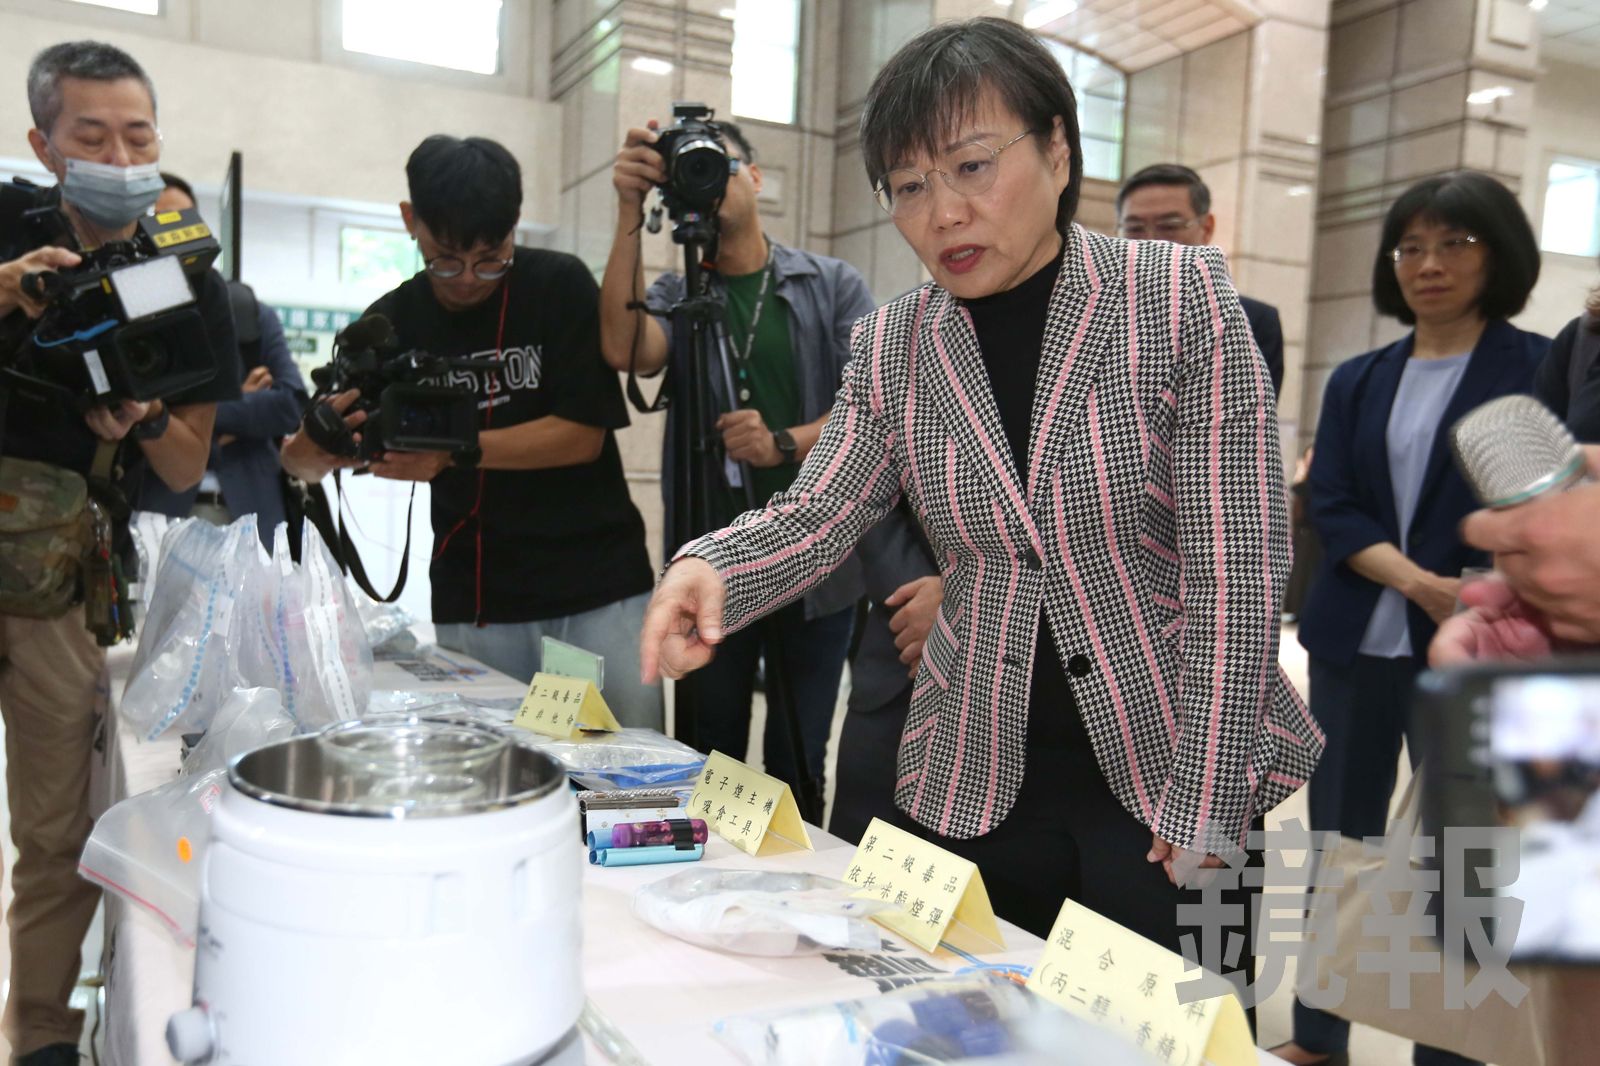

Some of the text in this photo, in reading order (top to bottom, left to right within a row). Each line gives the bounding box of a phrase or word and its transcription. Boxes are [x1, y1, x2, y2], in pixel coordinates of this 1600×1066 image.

[704, 768, 774, 816] 電子煙主機
[863, 834, 958, 894] 第二級毒品
